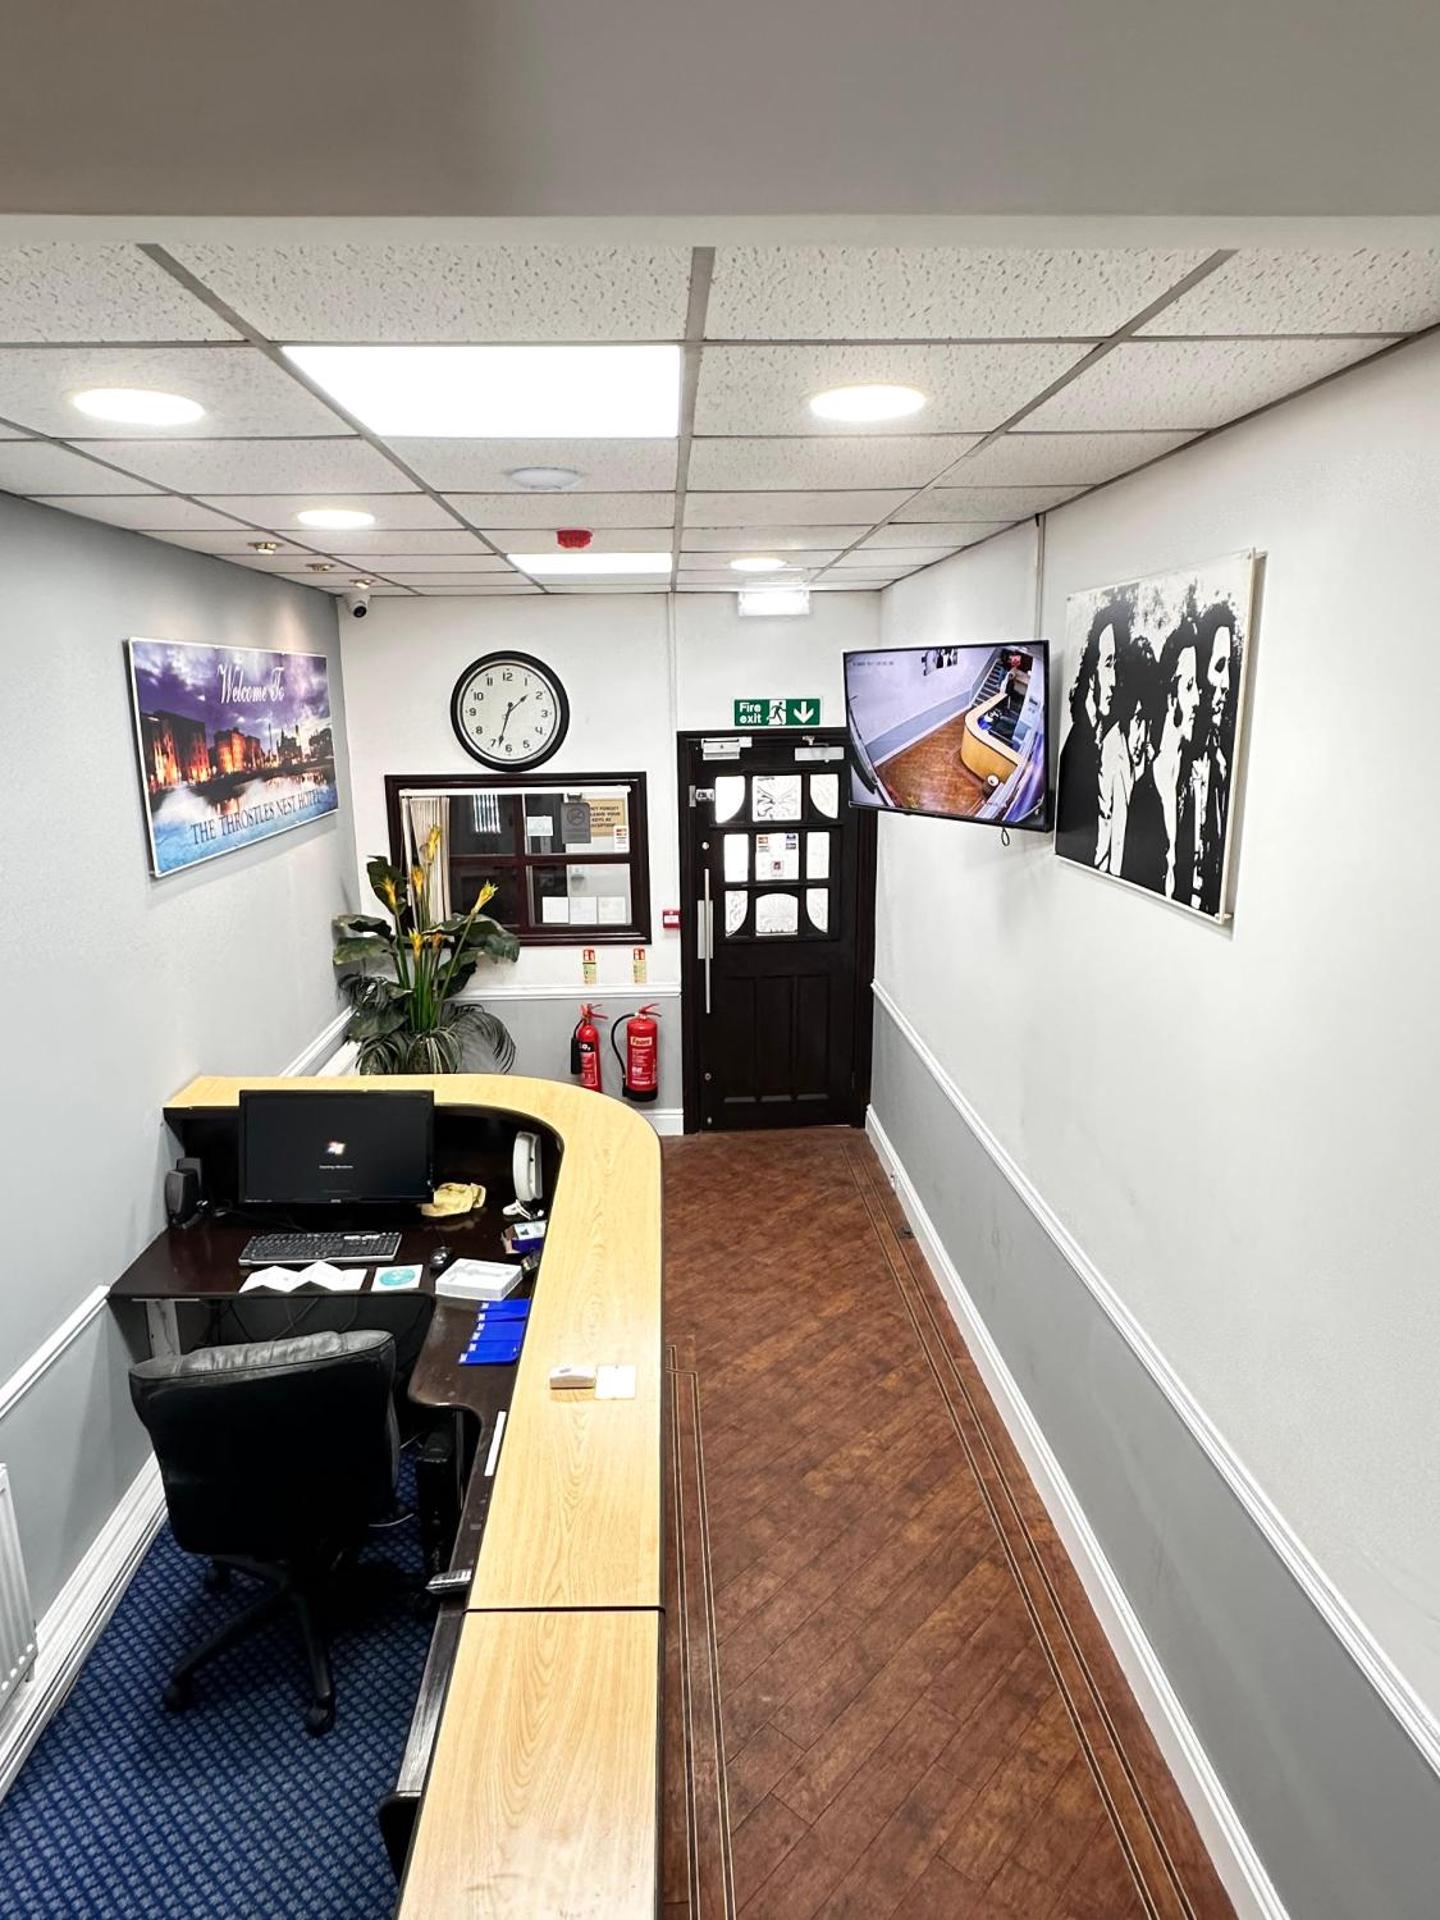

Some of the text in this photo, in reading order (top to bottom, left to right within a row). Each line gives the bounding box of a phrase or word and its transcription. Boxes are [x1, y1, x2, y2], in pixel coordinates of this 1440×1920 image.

[486, 677, 494, 686] 11
[502, 672, 513, 682] 12
[216, 664, 285, 703] Welcome To
[473, 691, 484, 701] 10
[535, 691, 543, 700] 2
[469, 707, 477, 716] 9
[739, 702, 762, 713] Fire
[541, 709, 549, 718] 3
[739, 714, 762, 724] exit
[475, 726, 483, 734] 8
[535, 726, 543, 735] 4
[490, 738, 497, 747] 7
[522, 740, 530, 749] 5
[505, 744, 513, 753] 6
[189, 818, 217, 845] THE
[219, 802, 275, 837] THROSTLES
[275, 795, 297, 817] NEST
